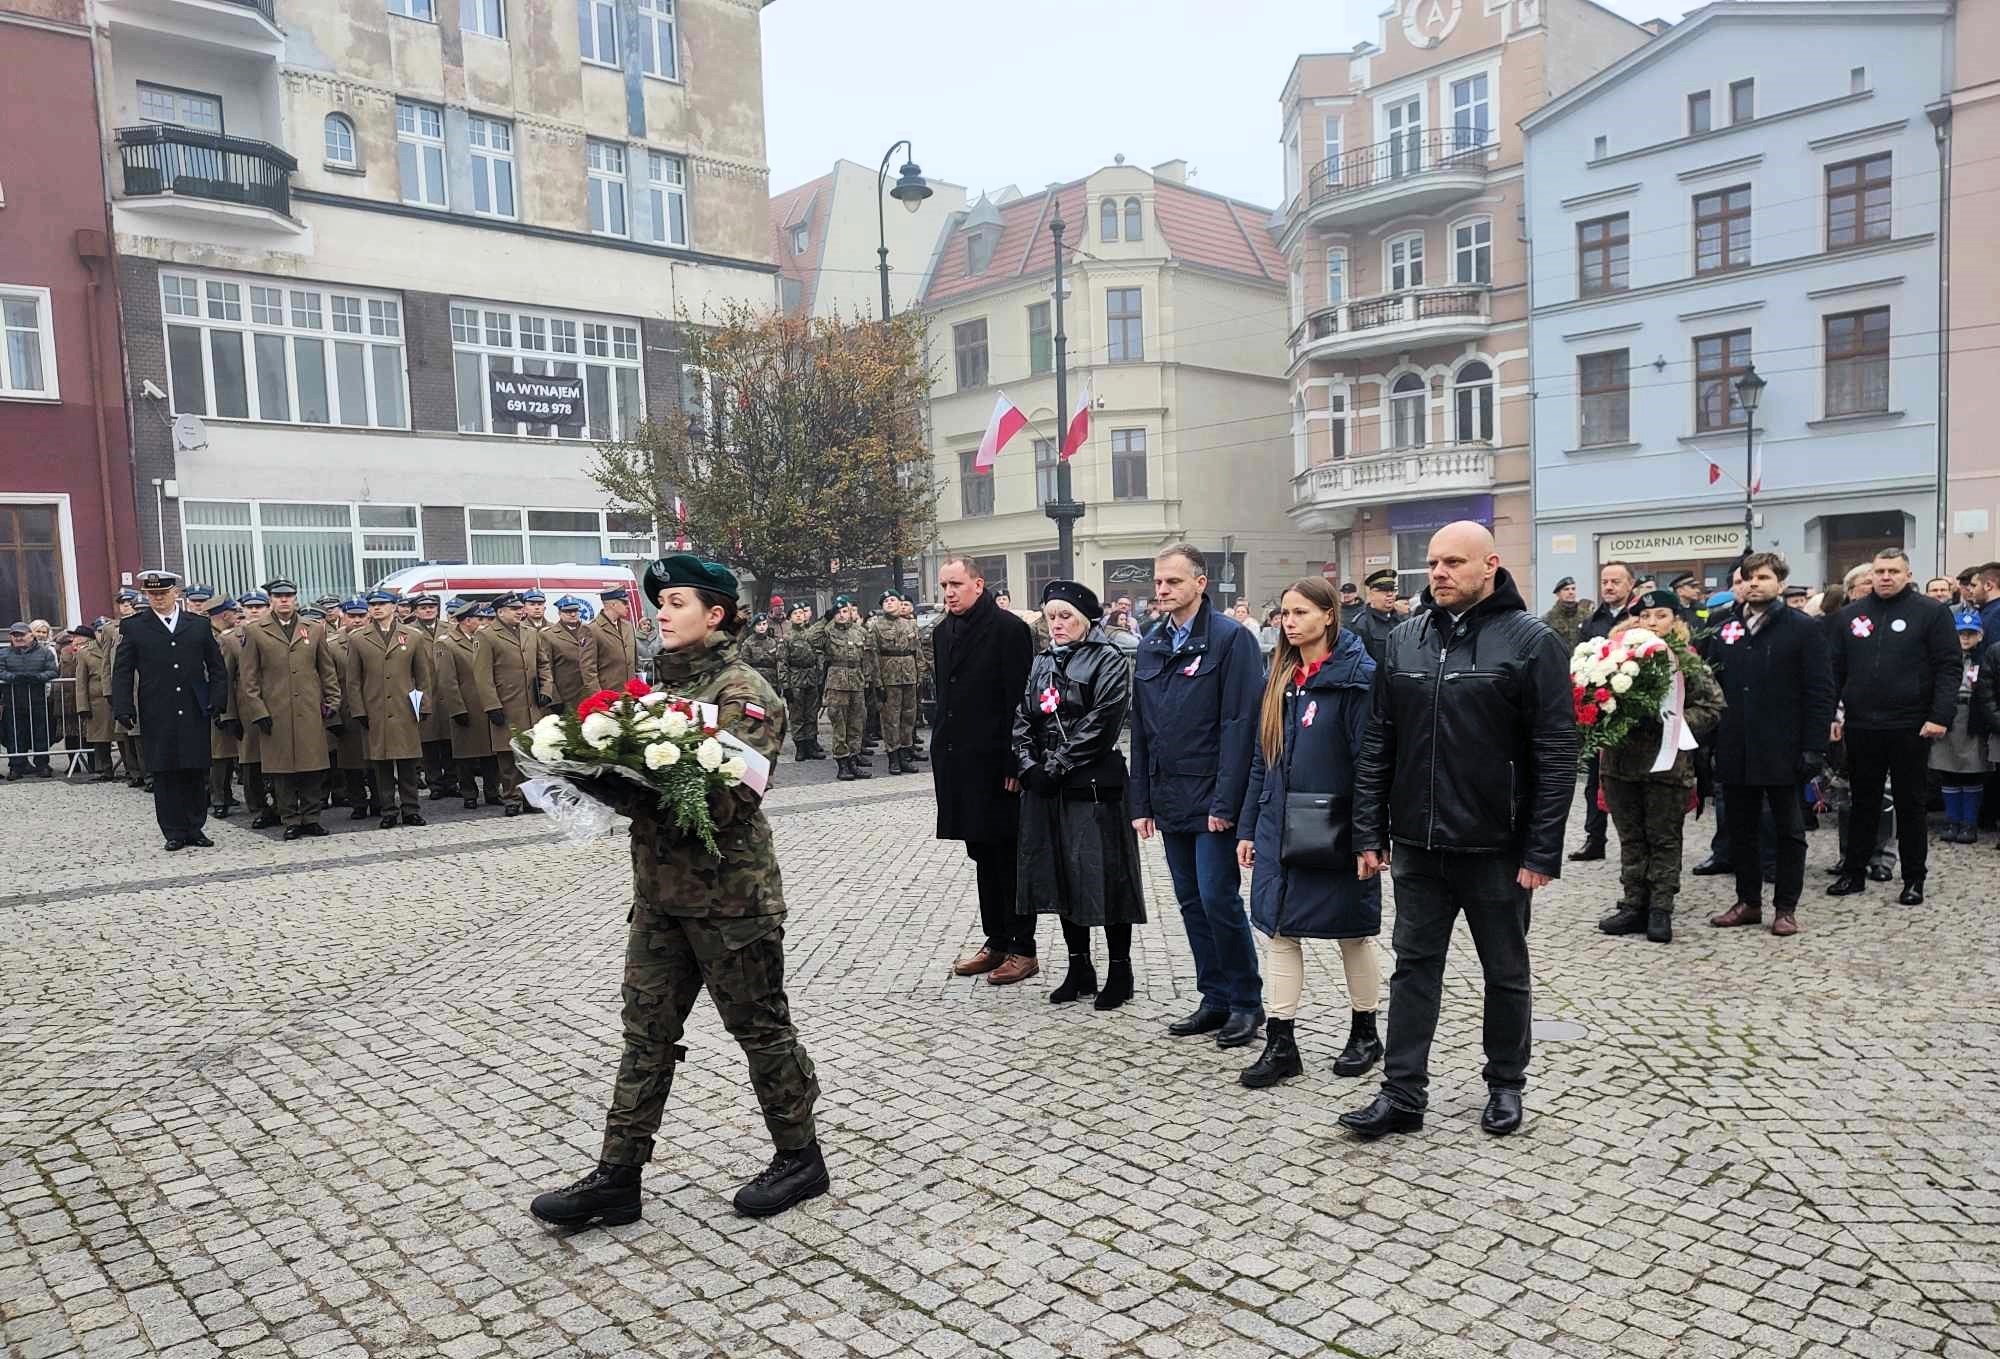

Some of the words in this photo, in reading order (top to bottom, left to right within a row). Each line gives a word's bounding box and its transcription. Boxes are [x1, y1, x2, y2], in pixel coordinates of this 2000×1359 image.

[495, 381, 516, 394] NA
[517, 383, 580, 399] WYNAJEM
[507, 400, 526, 412] 691
[528, 402, 549, 413] 728
[551, 403, 572, 415] 978
[1610, 535, 1684, 551] LODZIARNIA
[1687, 532, 1739, 546] TORINO
